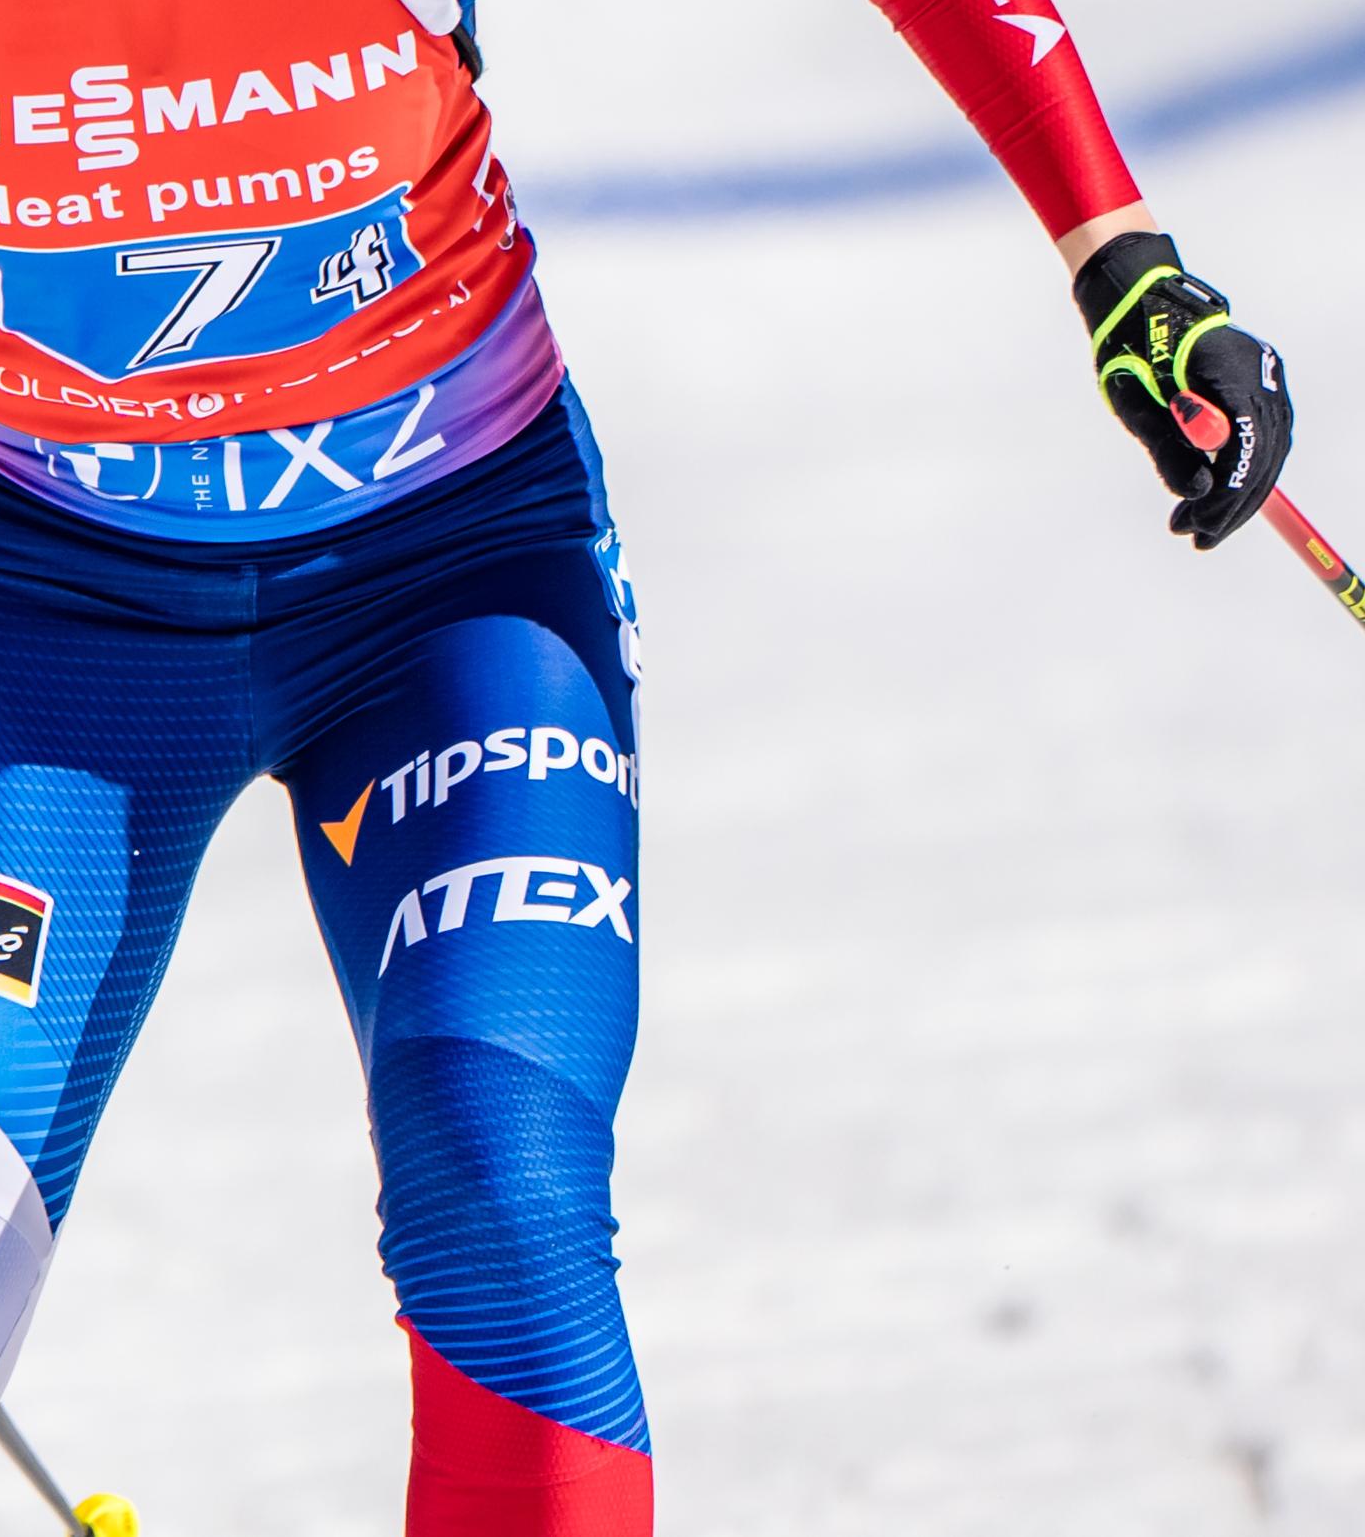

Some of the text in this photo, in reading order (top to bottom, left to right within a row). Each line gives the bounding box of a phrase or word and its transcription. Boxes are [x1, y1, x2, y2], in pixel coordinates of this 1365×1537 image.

[147, 144, 381, 223] pumps
[116, 236, 282, 369] 7
[311, 222, 396, 312] 4
[195, 470, 212, 511] THE
[378, 856, 635, 980] ATEX
